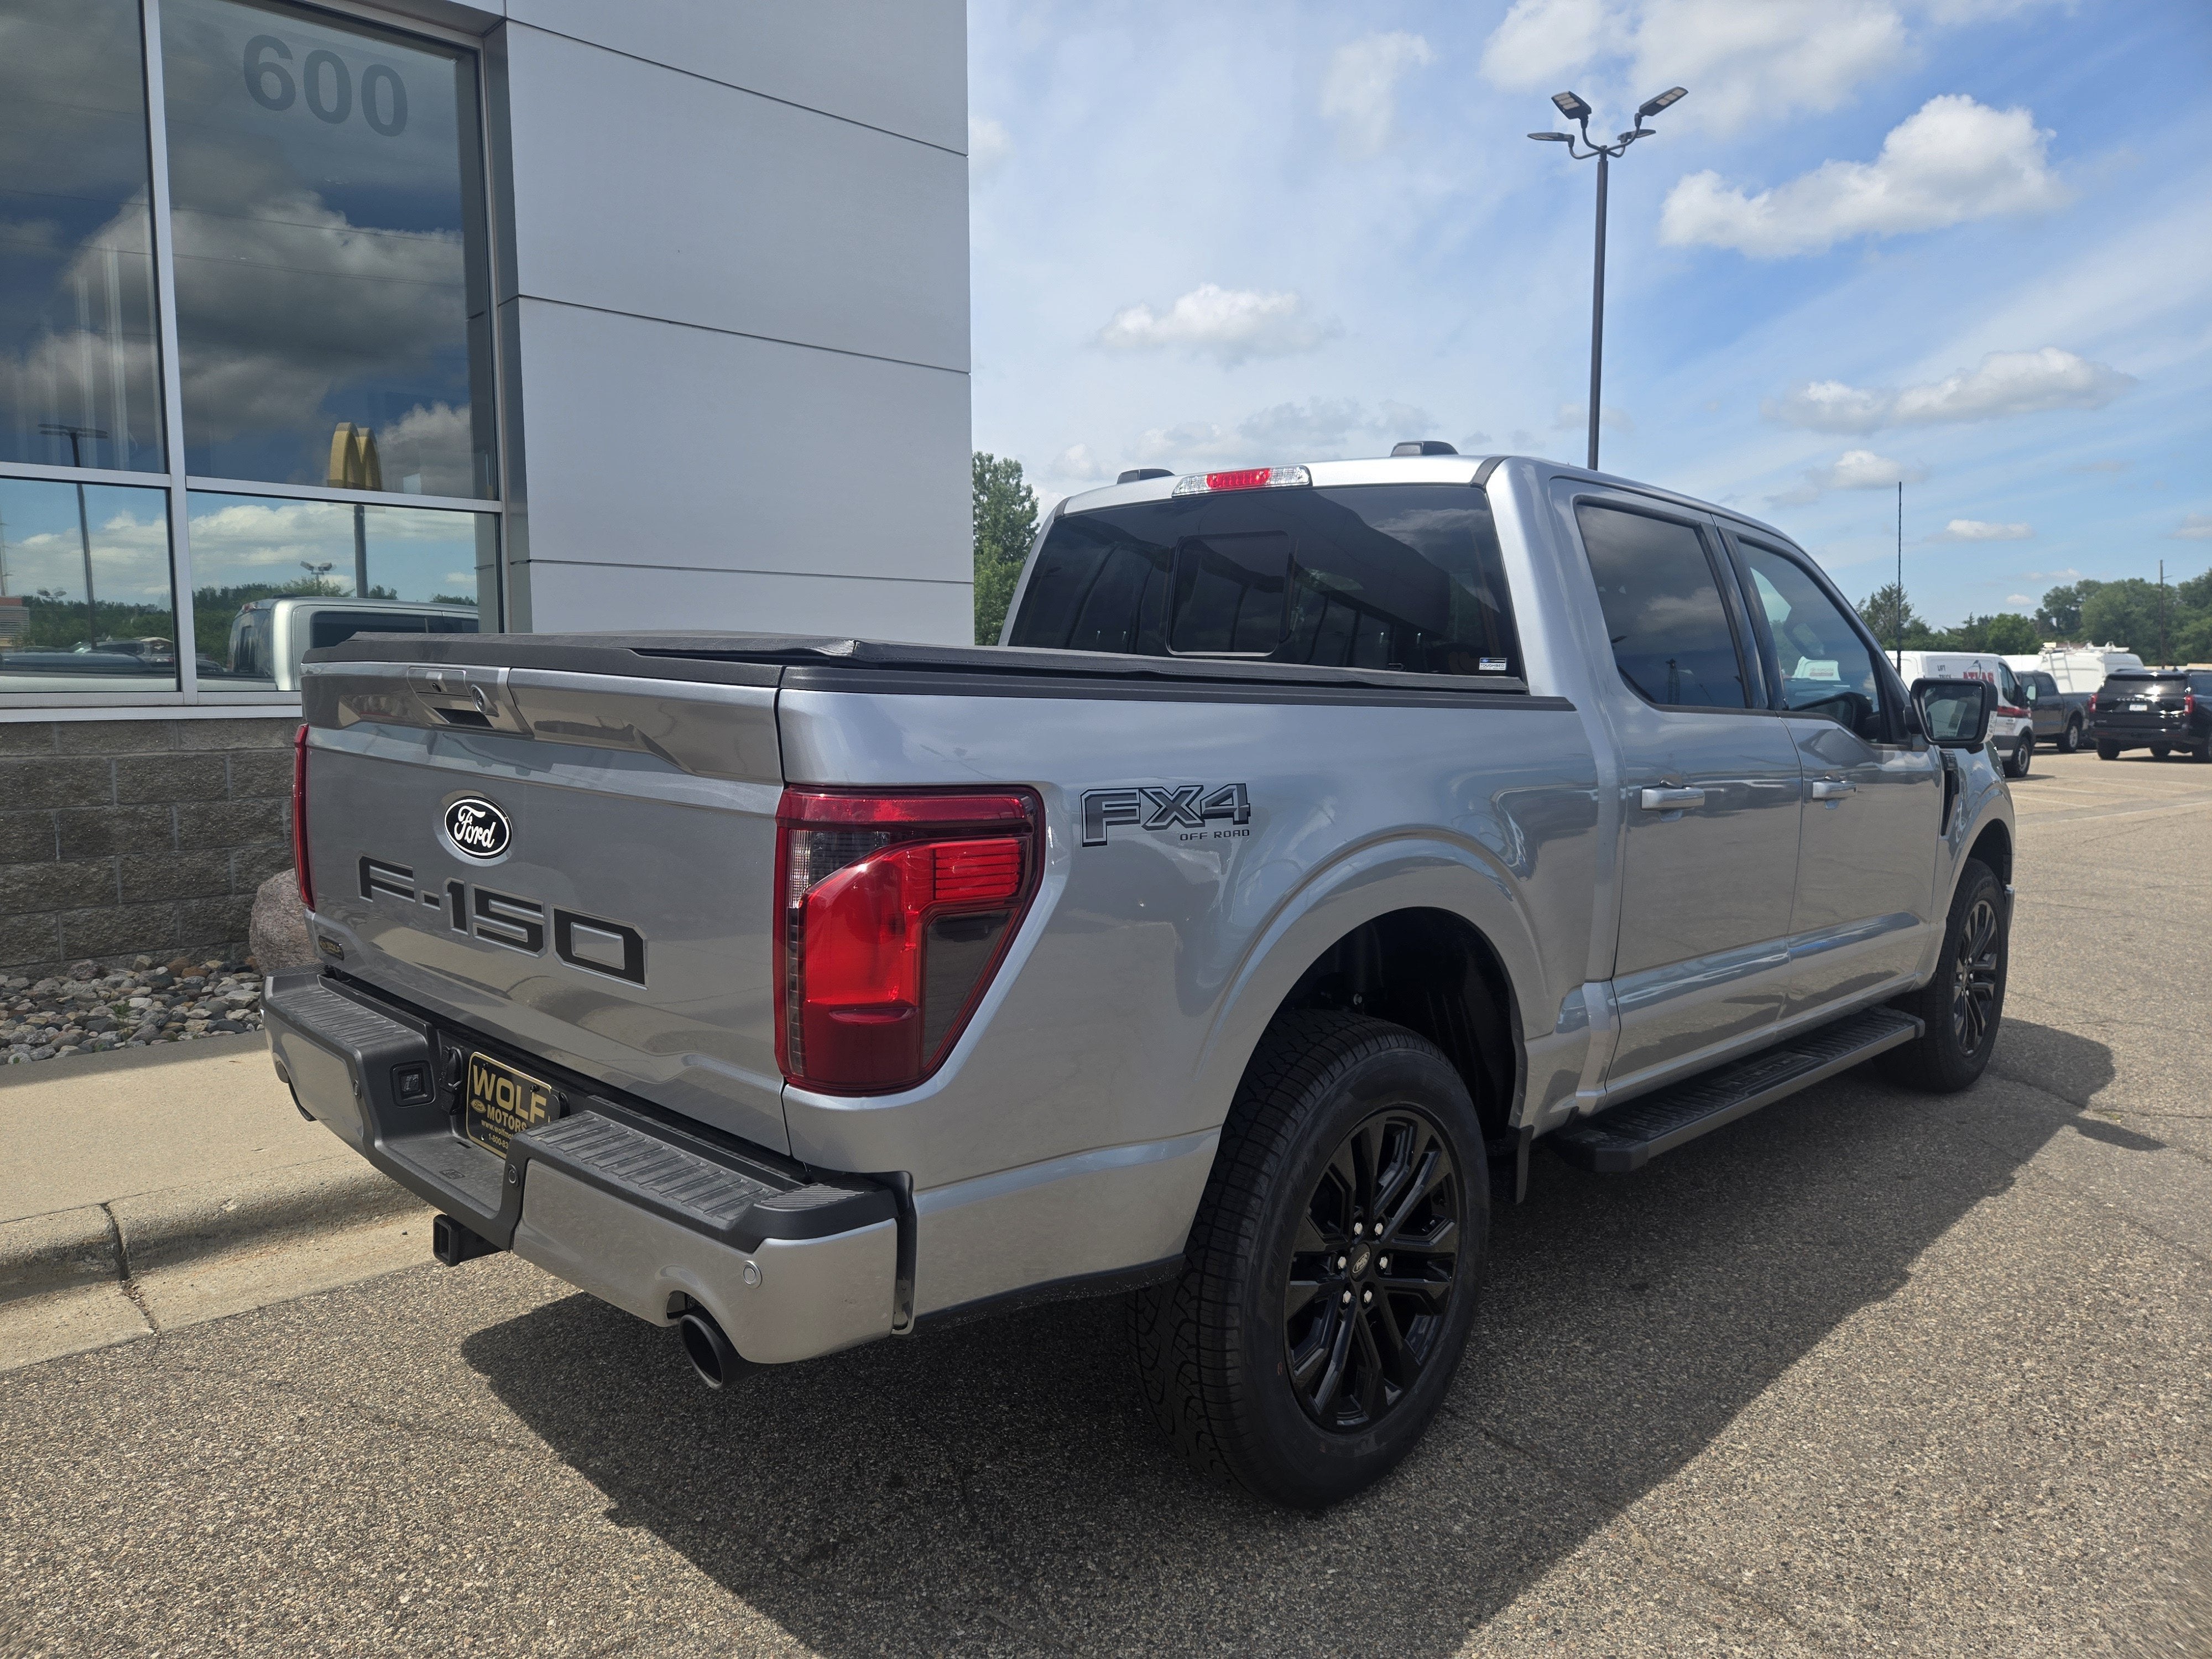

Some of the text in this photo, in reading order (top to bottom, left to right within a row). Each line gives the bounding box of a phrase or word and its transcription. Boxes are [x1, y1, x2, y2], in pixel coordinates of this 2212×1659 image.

[243, 34, 408, 137] 600
[454, 805, 497, 848] Ford
[1079, 782, 1251, 848] FX4
[1180, 829, 1250, 841] OFF ROAD
[358, 855, 648, 990] F-150
[473, 1065, 547, 1124] WOLF
[487, 1104, 527, 1133] MOTORS
[488, 1133, 509, 1149] 1-800-83
